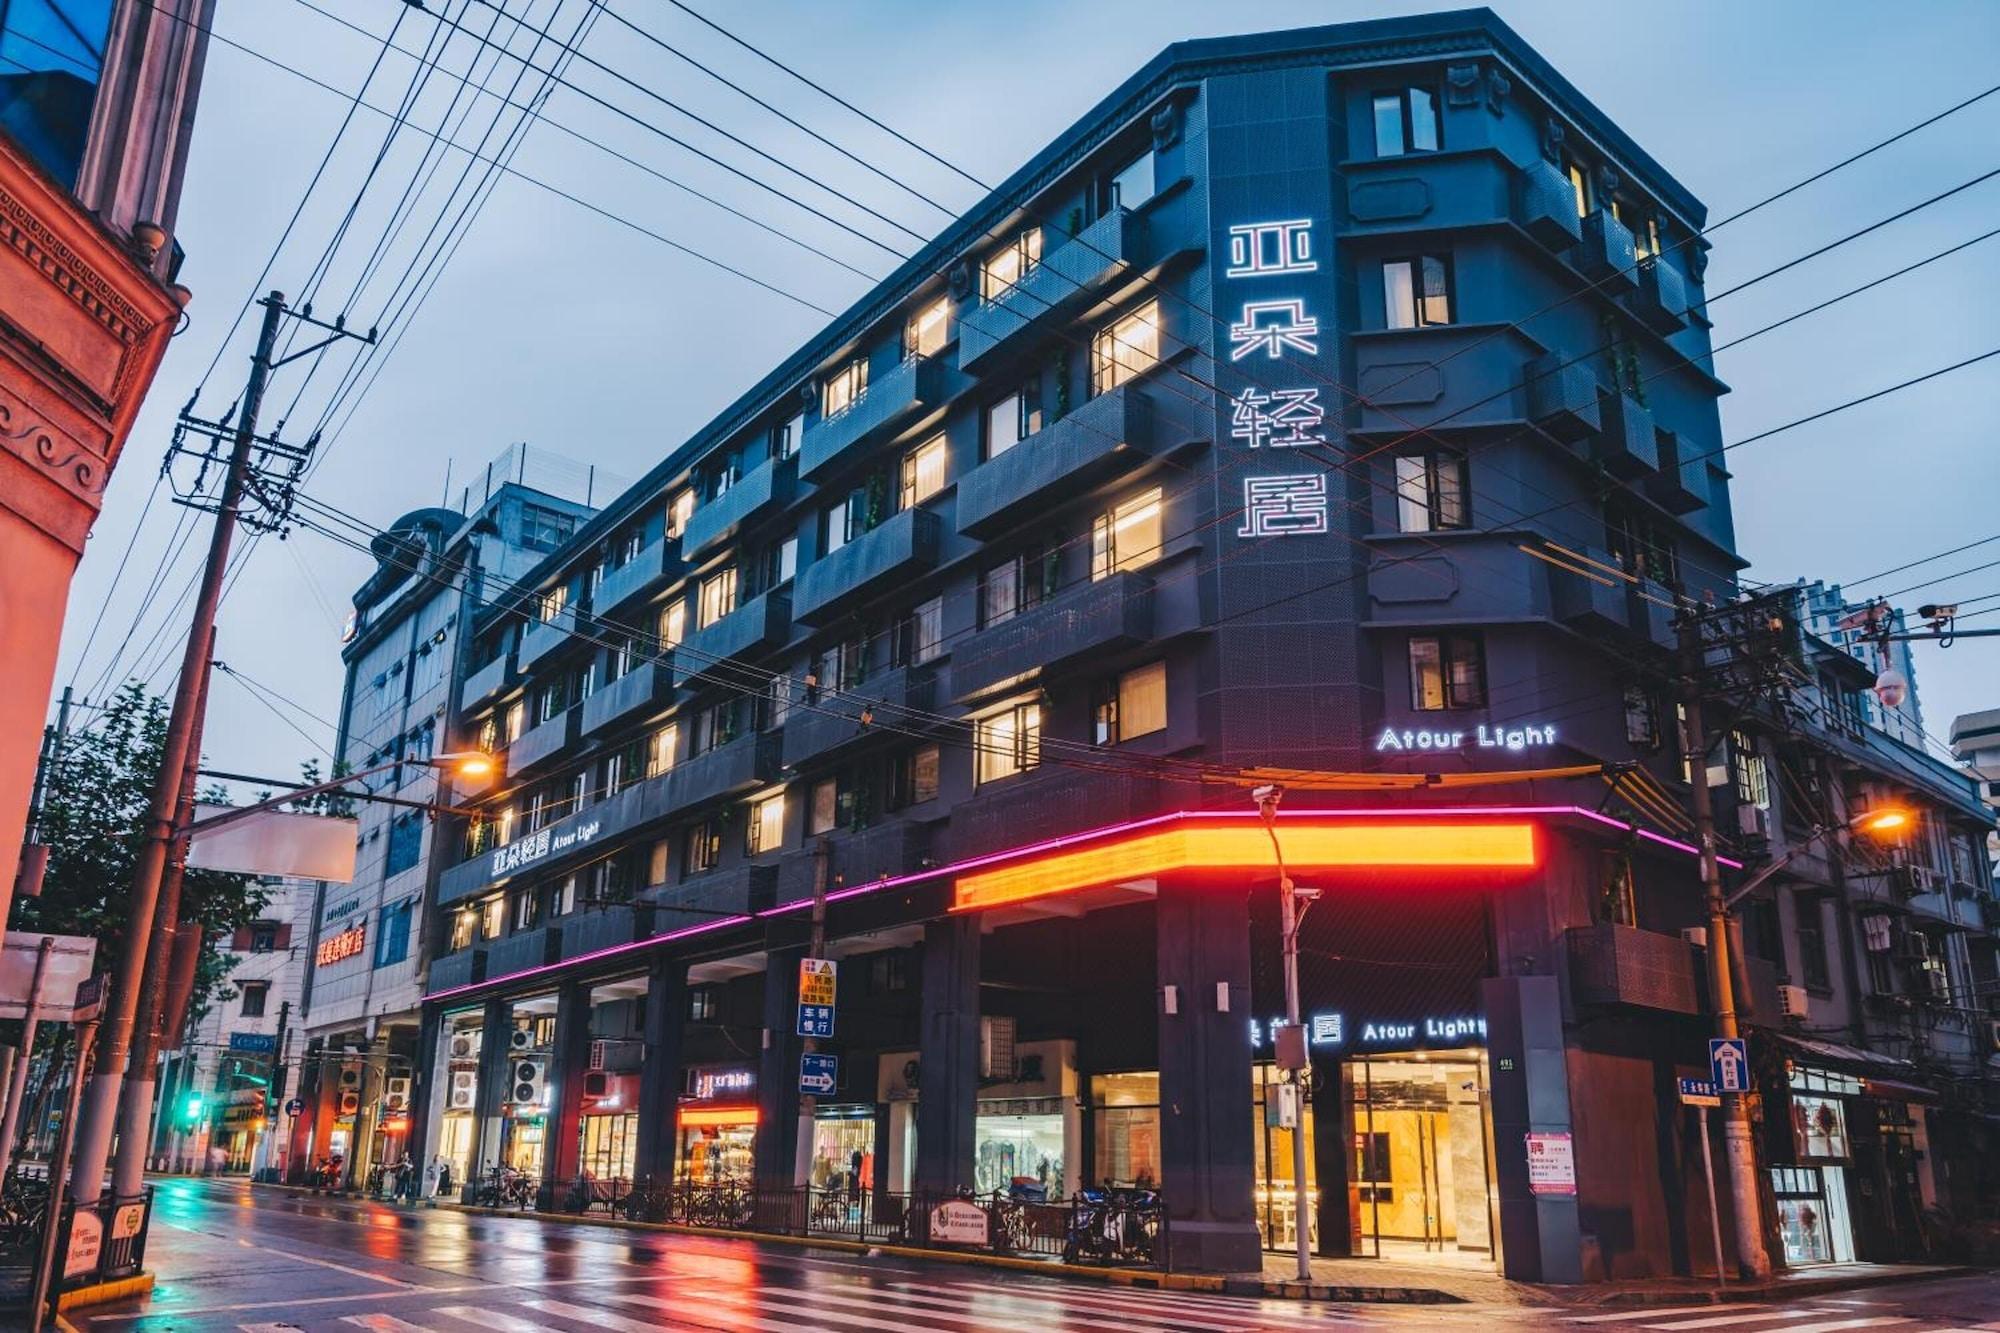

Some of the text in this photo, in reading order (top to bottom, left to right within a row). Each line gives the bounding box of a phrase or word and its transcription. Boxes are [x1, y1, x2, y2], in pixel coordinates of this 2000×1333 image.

[1226, 218, 1328, 538] 亚朵轻居
[1376, 725, 1556, 750] Atour Light
[552, 821, 600, 852] Atour Light
[491, 829, 550, 877] 亚朵轻居
[803, 1008, 829, 1019] 车辆
[803, 1020, 828, 1033] 慢行
[1363, 1024, 1415, 1041] Atour
[1427, 1018, 1479, 1039] Light
